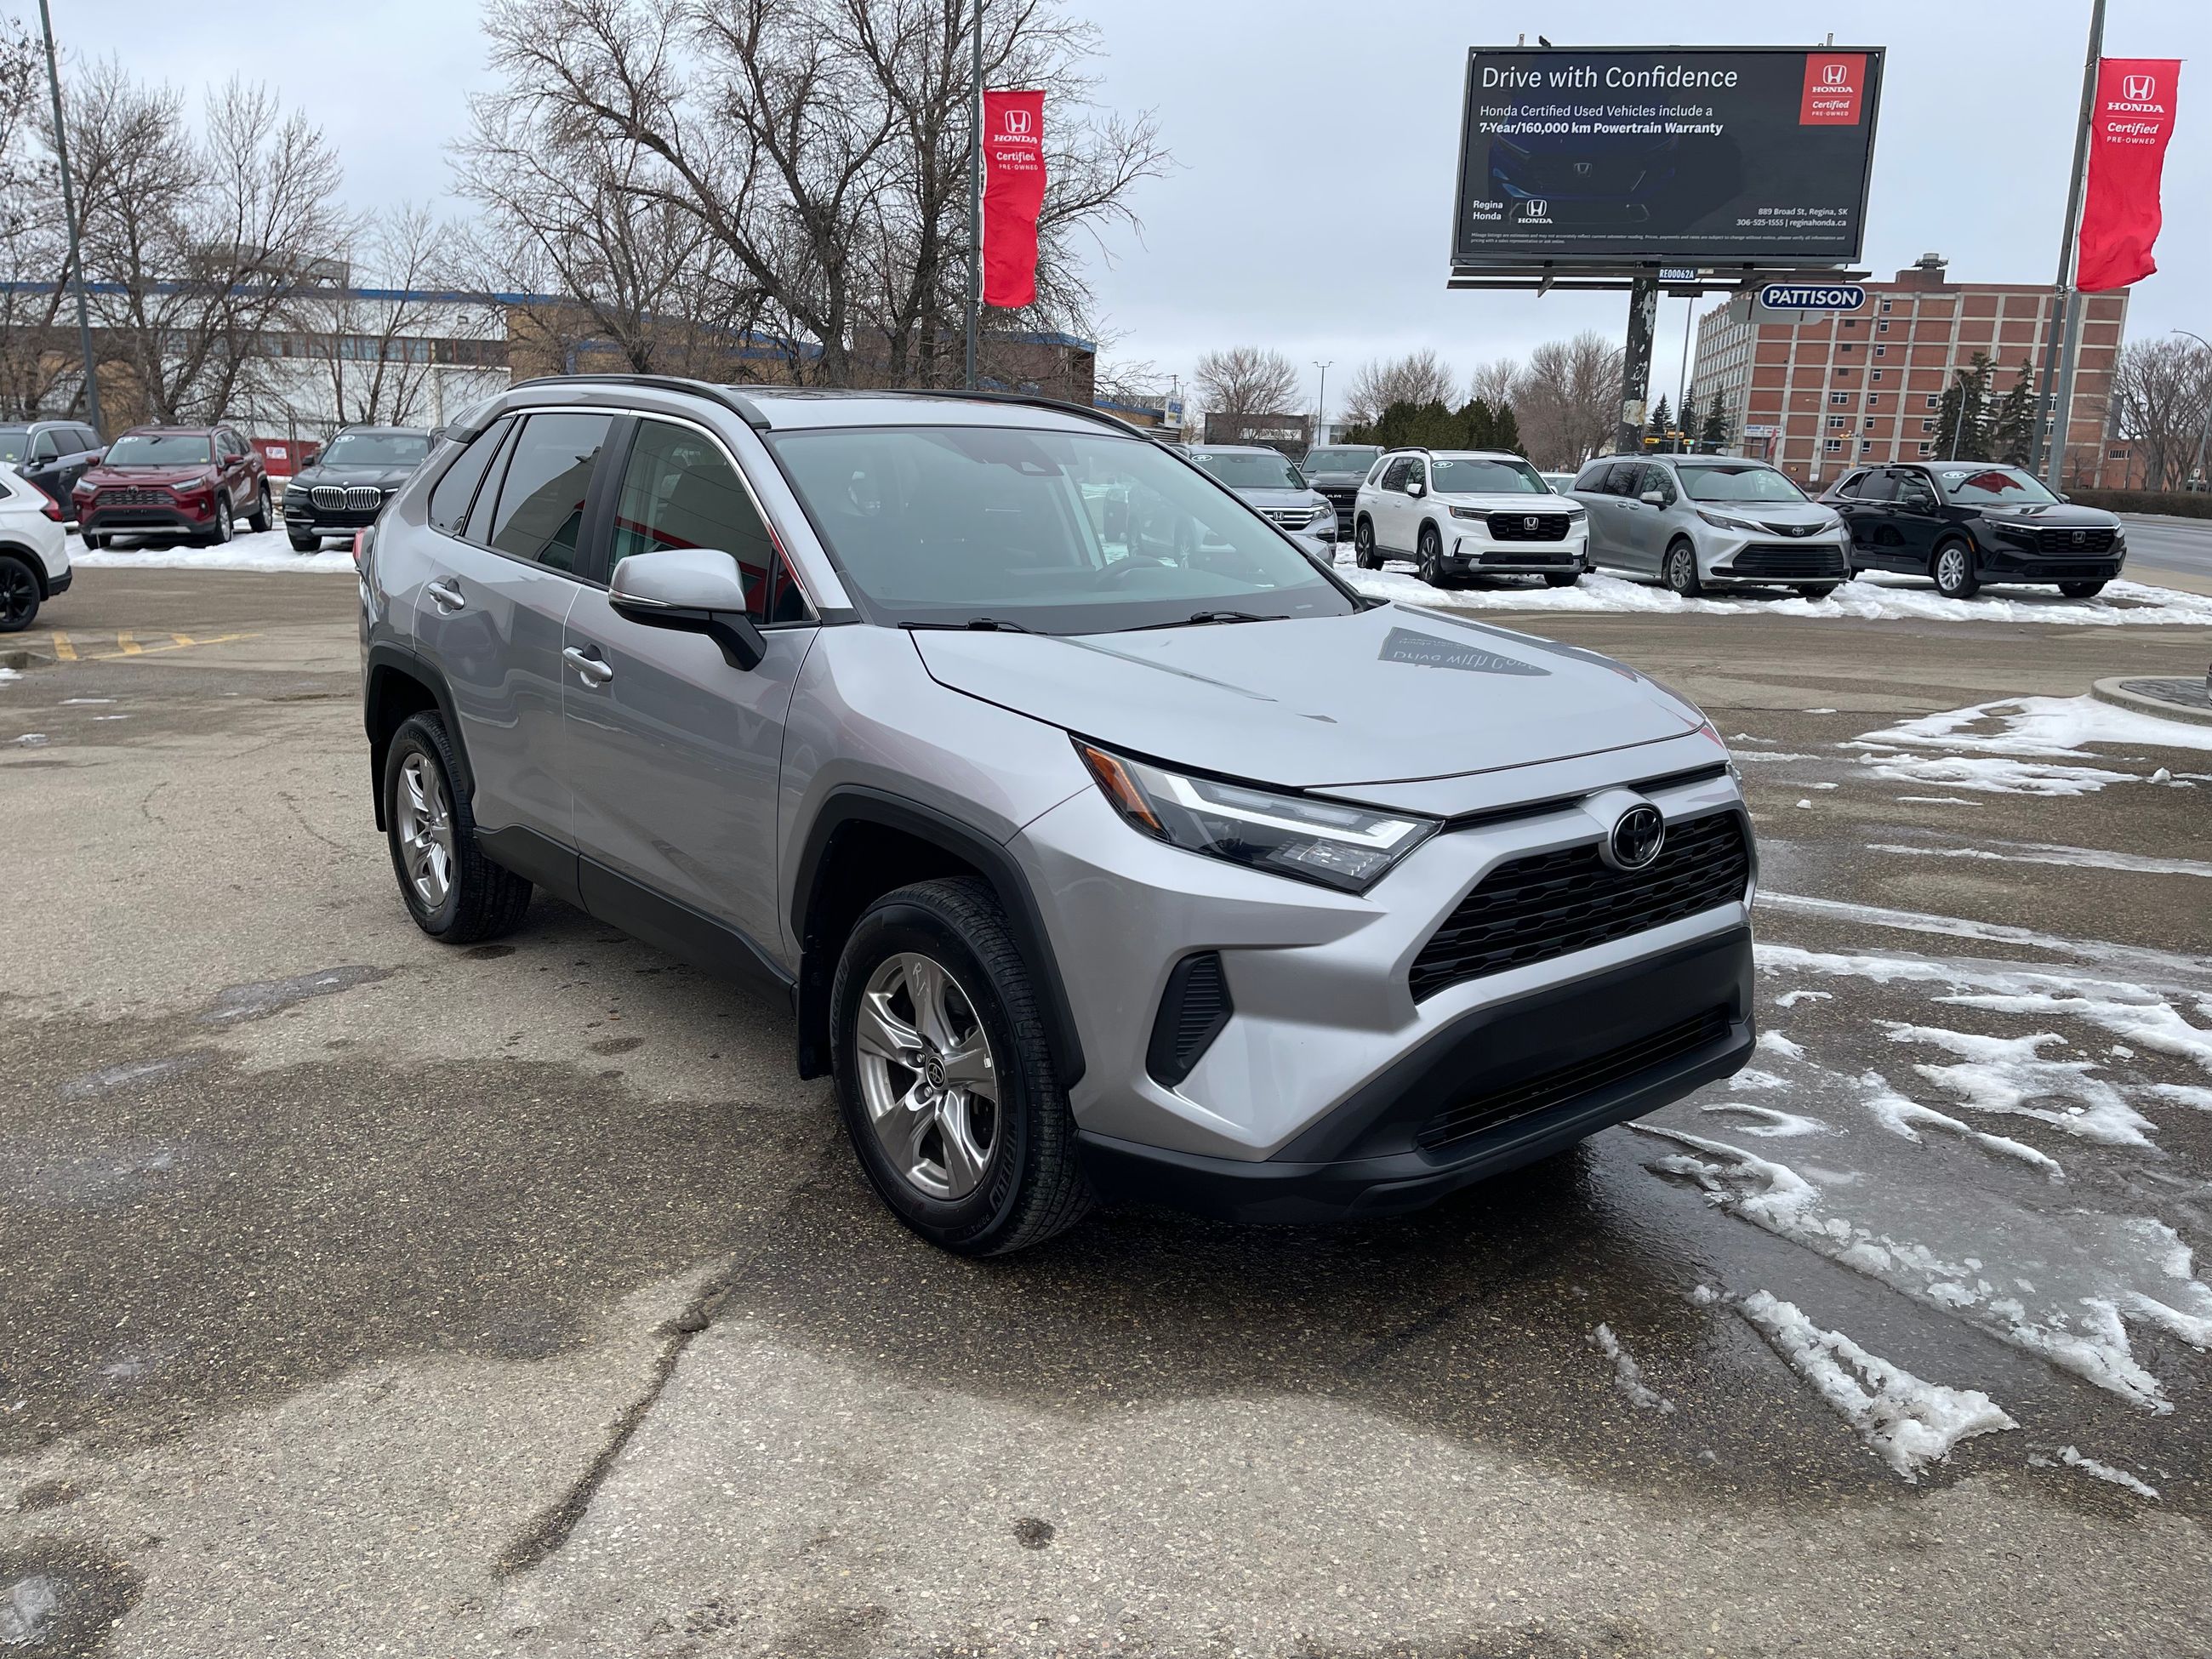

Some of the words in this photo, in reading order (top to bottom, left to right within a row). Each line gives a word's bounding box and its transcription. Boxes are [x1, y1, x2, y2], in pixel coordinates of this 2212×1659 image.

[1482, 66, 1542, 88] Drive
[1548, 66, 1598, 88] with
[1605, 65, 1738, 88] Confidence
[1812, 100, 1850, 111] Certified
[2107, 102, 2164, 113] HONDA
[1479, 105, 1518, 117] Honda
[1520, 105, 1571, 117] Certified
[1574, 105, 1604, 117] Used
[1606, 105, 1656, 117] Vehicles
[1659, 105, 1702, 117] include
[1705, 107, 1713, 117] a
[1479, 122, 1569, 134] 7-Year/160,000
[1571, 122, 1591, 134] km
[1593, 122, 1662, 134] Powertrain
[1664, 123, 1724, 136] Warranty
[2107, 123, 2159, 136] Certified
[994, 134, 1038, 144] HONDA
[2107, 136, 2156, 145] PRE-OWNED
[1473, 200, 1503, 210] Regina
[1473, 212, 1502, 220] Honda
[1796, 208, 1807, 217] St,
[1809, 208, 1837, 217] Regina,
[1789, 219, 1847, 228] reginahonda.ca
[1659, 269, 1694, 279] RE00062A
[1768, 289, 1858, 305] PATTISON
